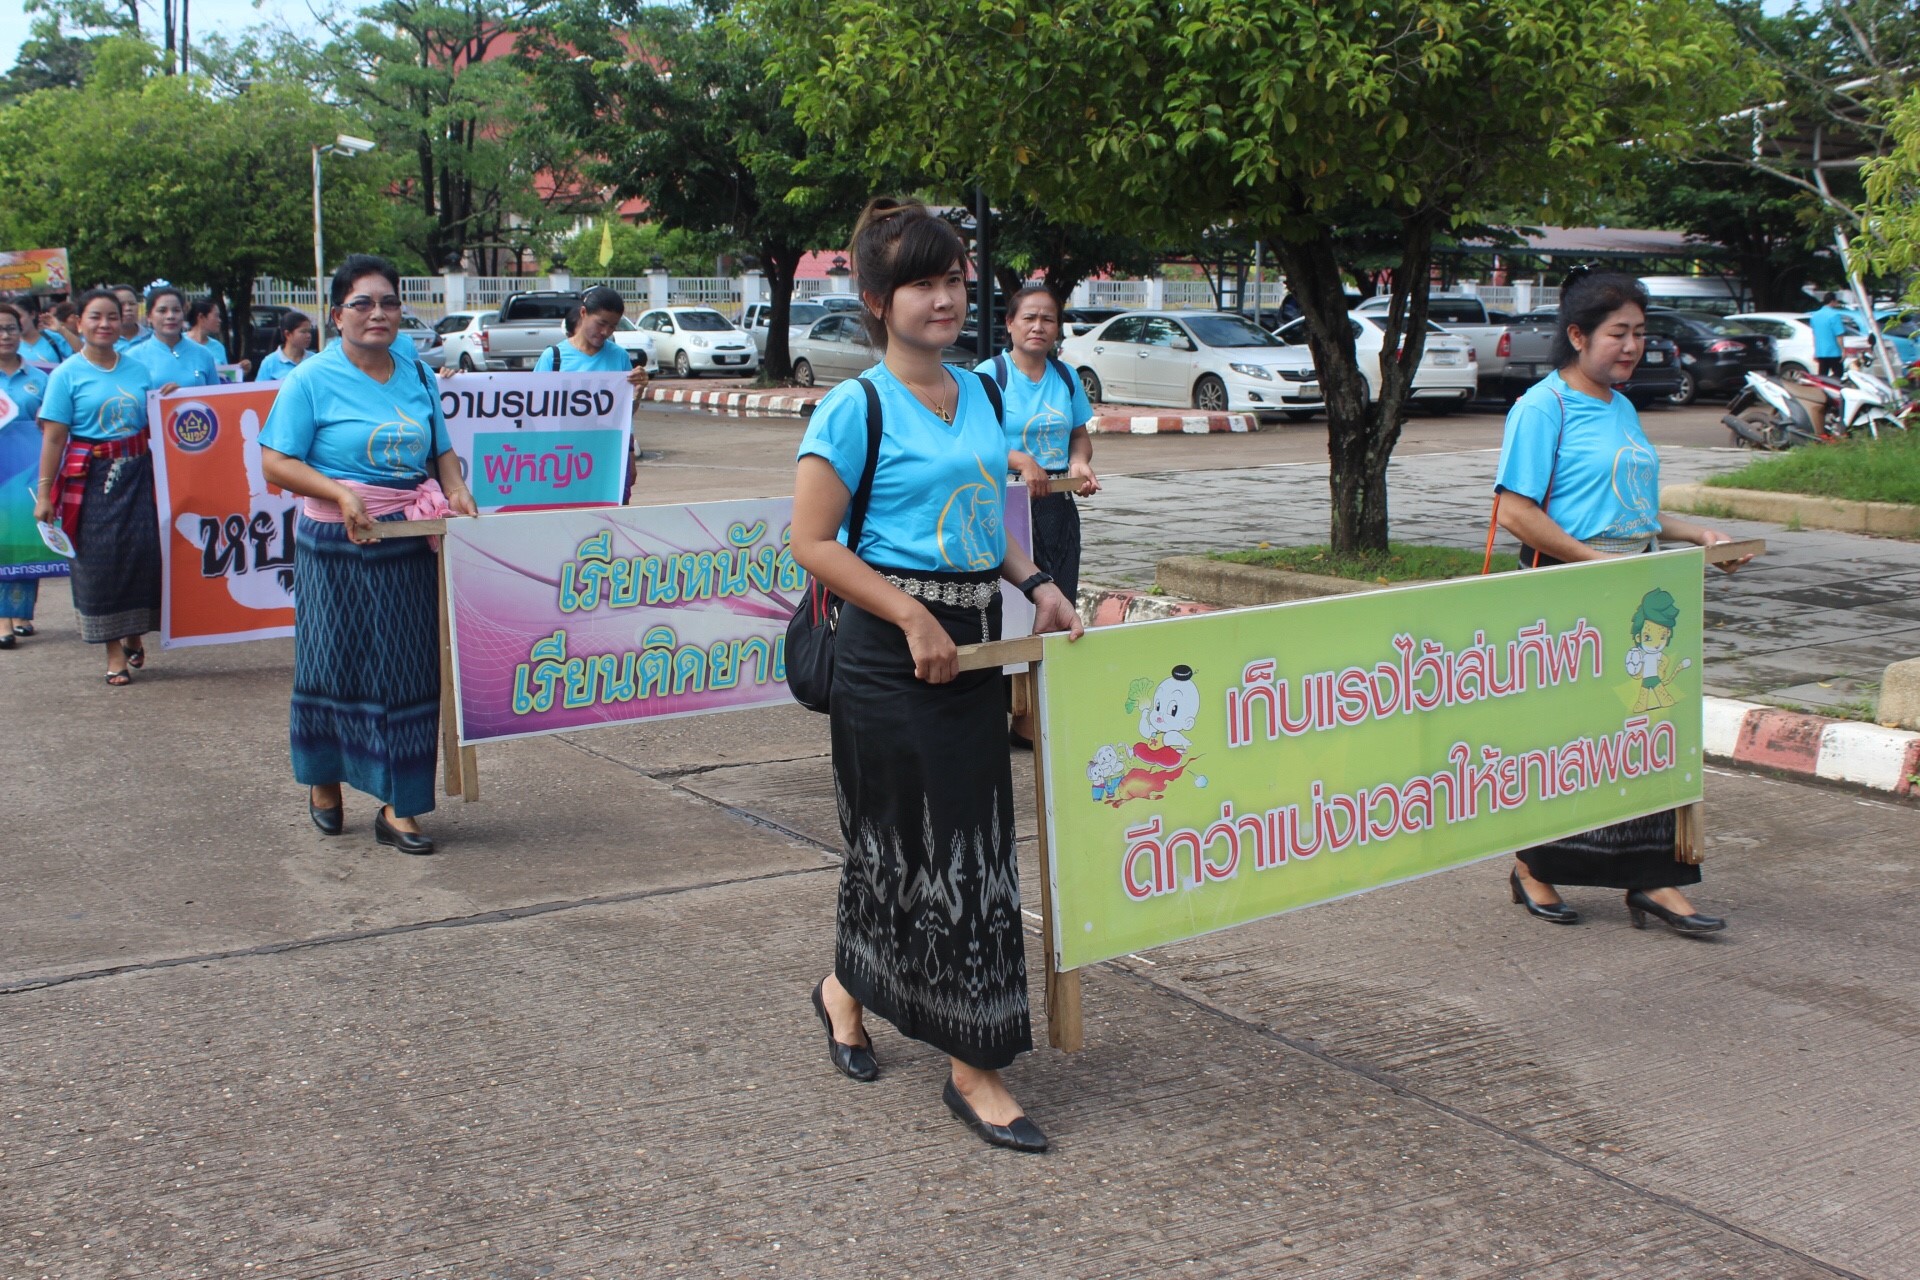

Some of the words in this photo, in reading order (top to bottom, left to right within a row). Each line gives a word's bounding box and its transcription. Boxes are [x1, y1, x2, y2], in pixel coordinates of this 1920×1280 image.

[440, 389, 614, 428] วามรุนแรง
[483, 444, 593, 494] ผู้หญิง
[200, 506, 296, 595] หยุ
[512, 627, 787, 714] เรียนติดยาเ
[1227, 619, 1602, 747] เก็บแรงไว้เล่นกีฬา
[1122, 716, 1677, 901] ดีกว่าแบ่งเวลาให้ยาเสพติด
